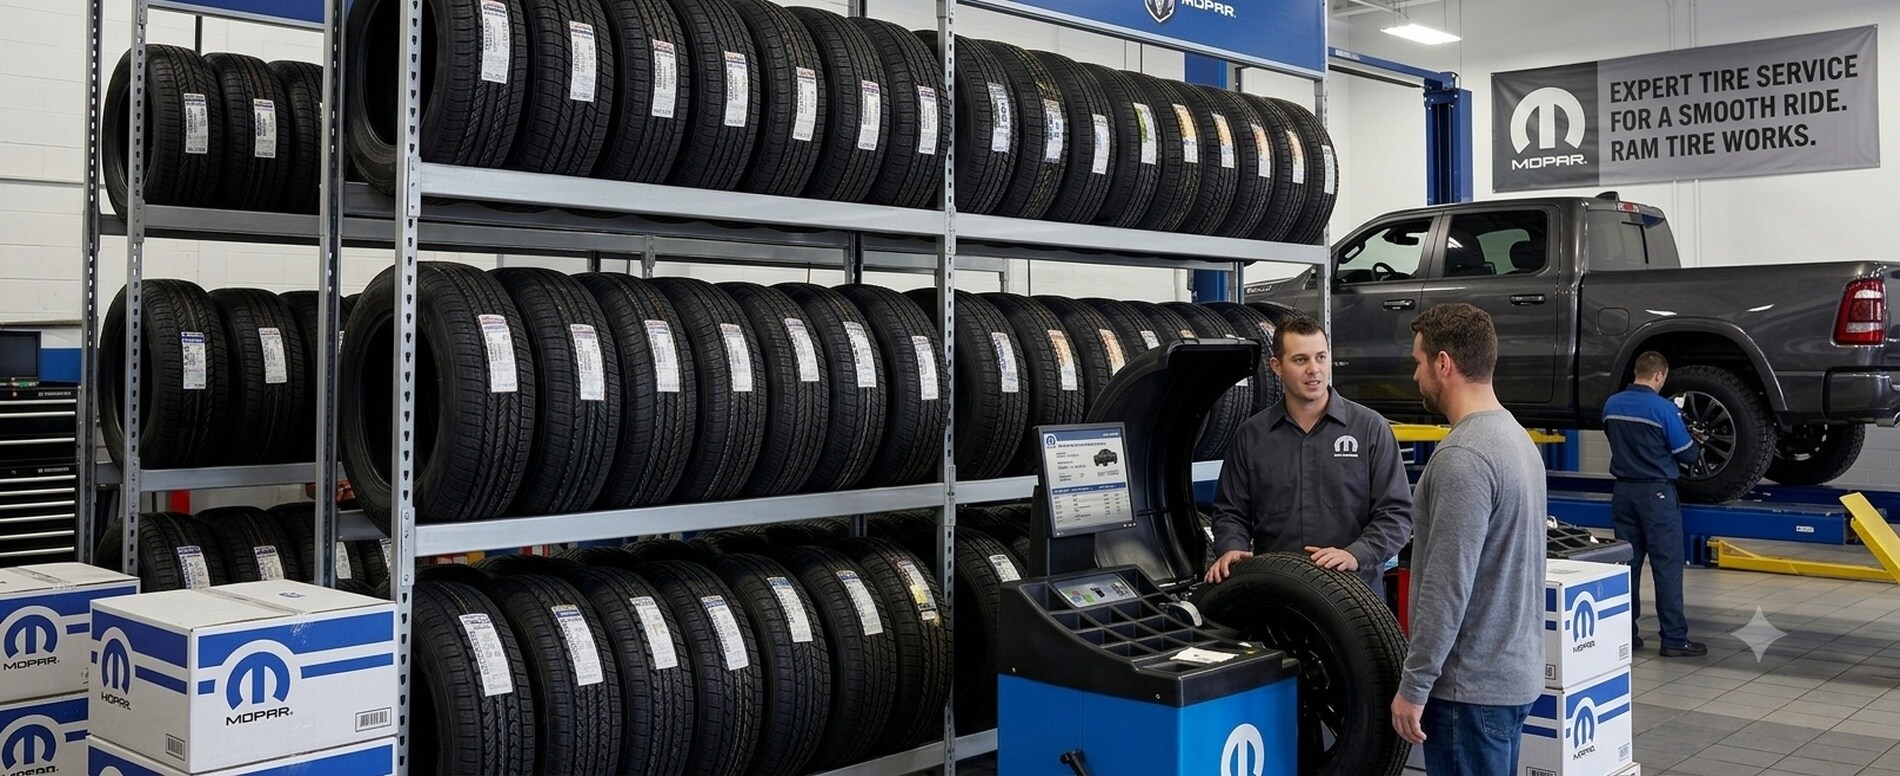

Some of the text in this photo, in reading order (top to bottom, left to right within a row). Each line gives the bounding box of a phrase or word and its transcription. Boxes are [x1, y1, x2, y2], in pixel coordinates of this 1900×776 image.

[1610, 54, 1858, 104] EXPERT TIRE SERVICE
[1610, 89, 1847, 132] FOR A SMOOTH RIDE.
[1611, 124, 1817, 162] RAM TIRE WORKS.
